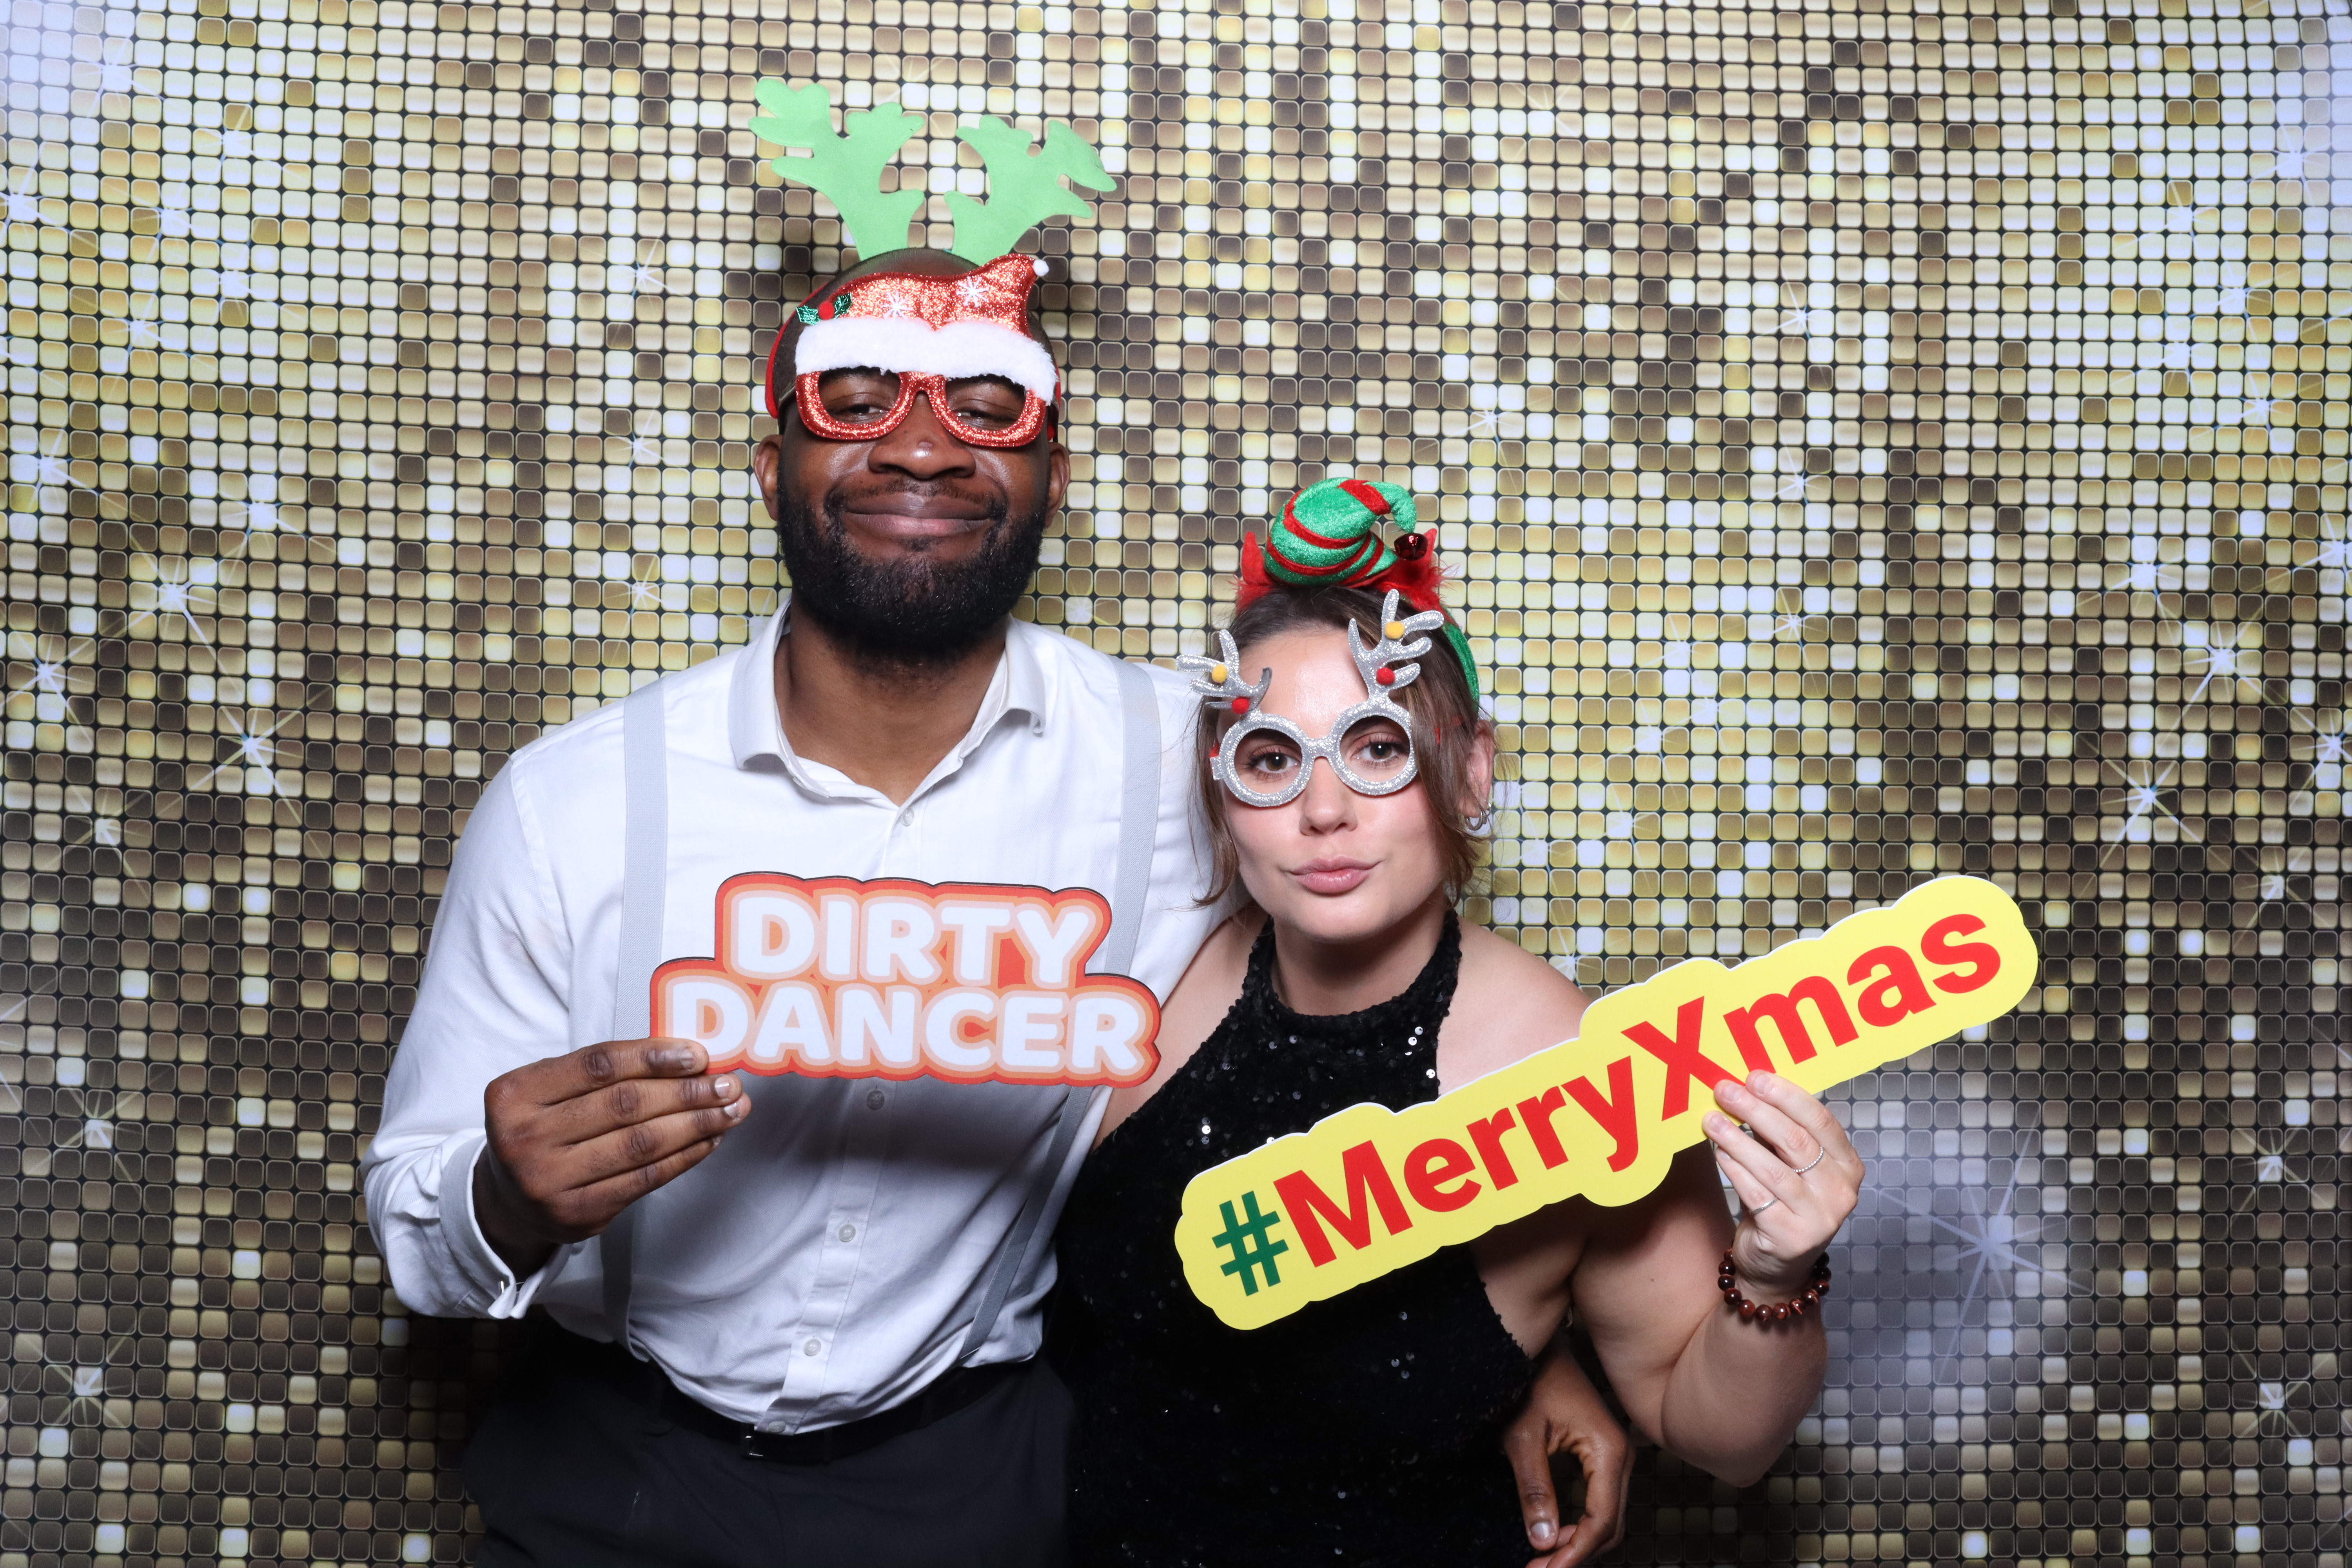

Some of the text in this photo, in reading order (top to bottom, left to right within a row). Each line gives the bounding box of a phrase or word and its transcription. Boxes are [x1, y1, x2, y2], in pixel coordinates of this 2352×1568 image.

[737, 895, 1090, 985] DIRTY
[672, 981, 1146, 1070] DANCER
[1212, 913, 2001, 1297] #MerryXmas
